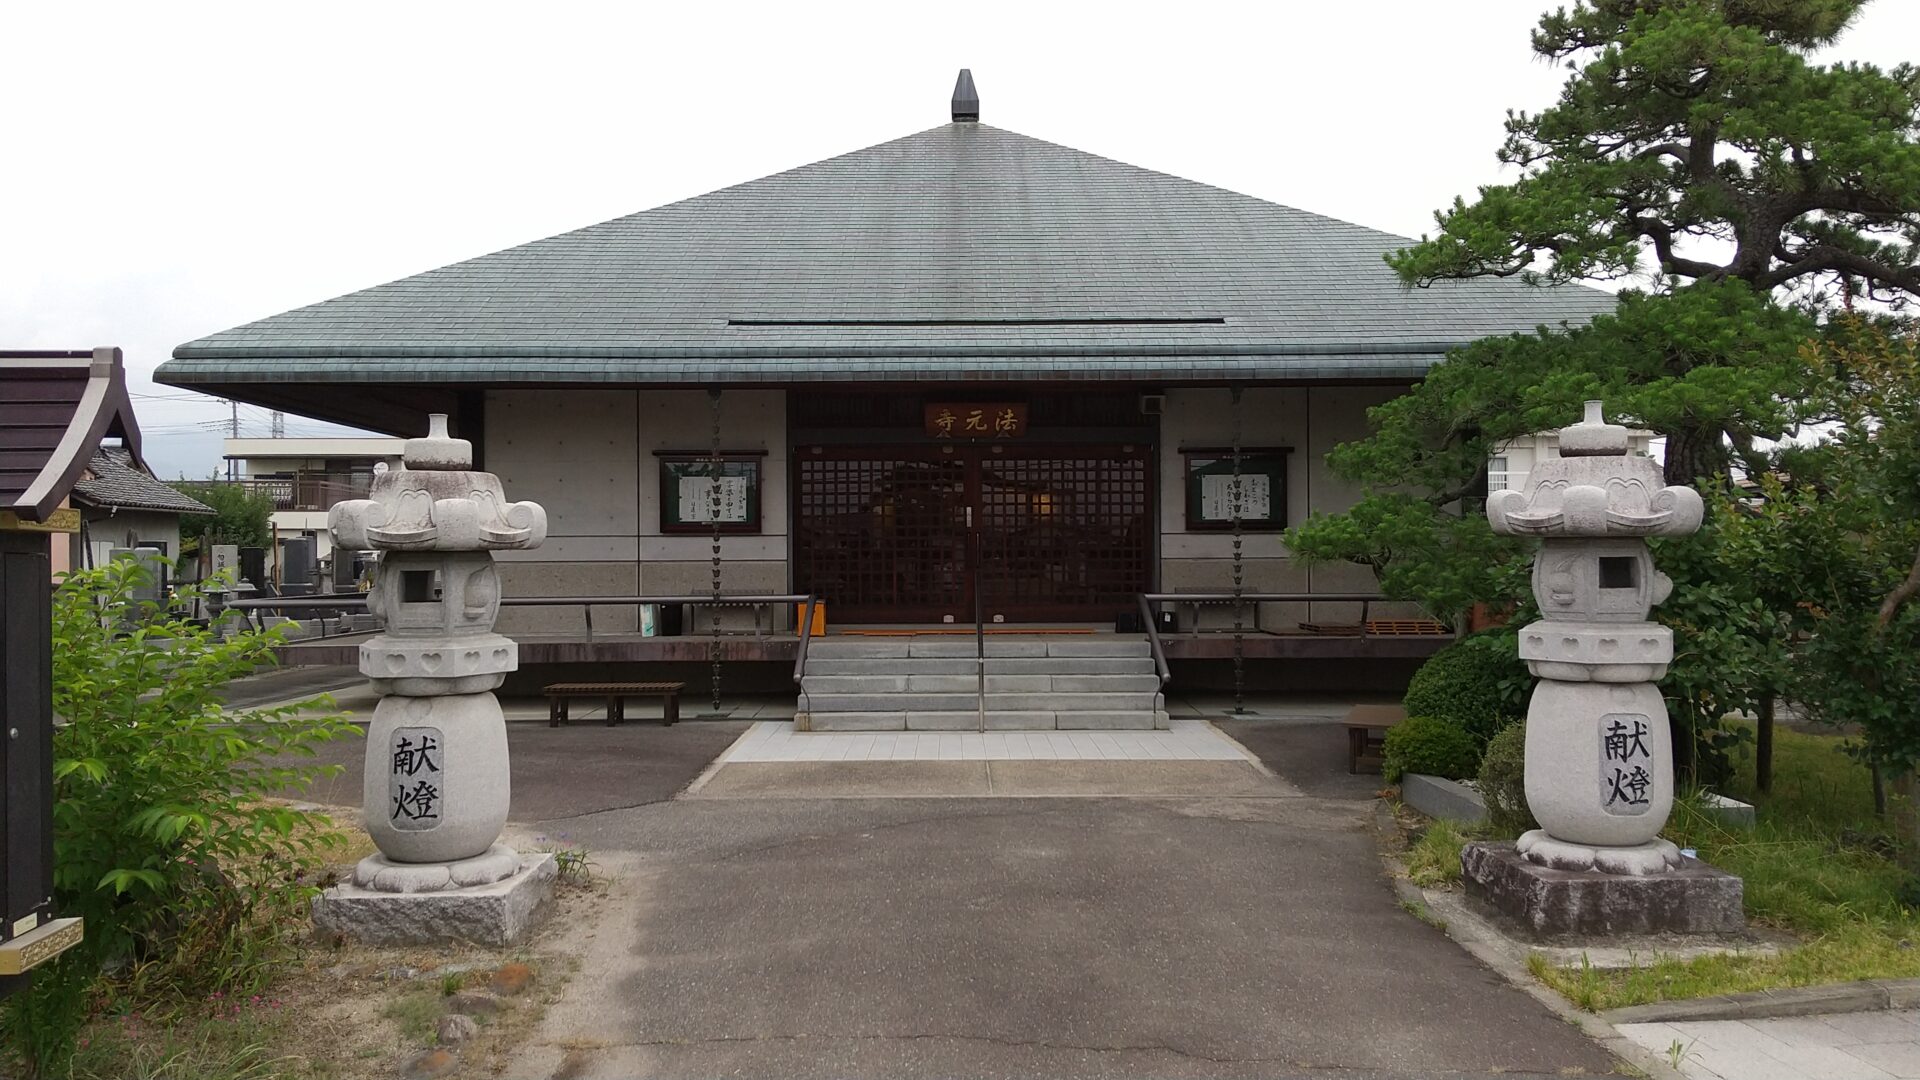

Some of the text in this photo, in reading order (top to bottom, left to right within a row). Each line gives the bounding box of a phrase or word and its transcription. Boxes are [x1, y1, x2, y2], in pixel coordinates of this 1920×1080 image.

[935, 408, 1018, 431] 法元寺
[392, 735, 440, 820] 献燈
[1604, 720, 1651, 806] 献燈
